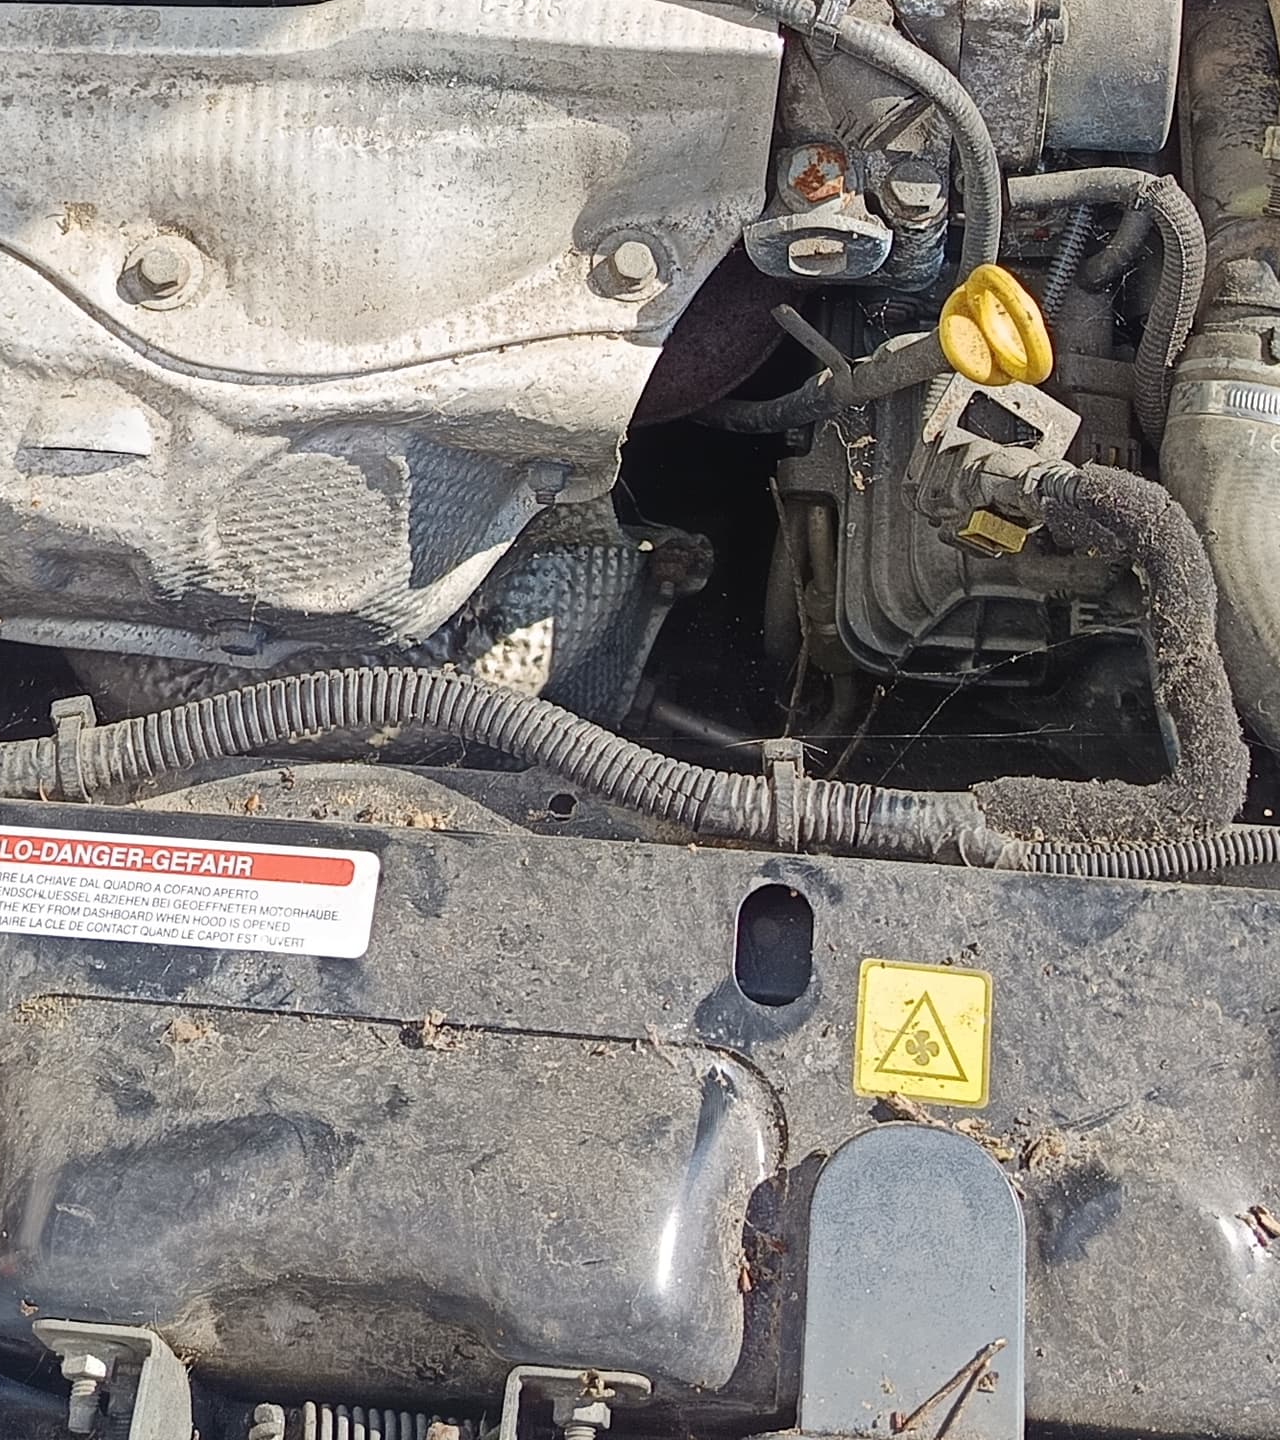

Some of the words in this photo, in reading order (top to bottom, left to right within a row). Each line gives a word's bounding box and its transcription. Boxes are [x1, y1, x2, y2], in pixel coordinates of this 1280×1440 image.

[20, 873, 34, 884] LA
[36, 874, 76, 887] CHIAVE
[80, 877, 100, 889] DAL
[103, 880, 151, 893] QUADRO
[154, 883, 162, 893] A
[164, 884, 211, 897] COFANO
[213, 888, 259, 900] APERTO
[22, 902, 45, 914] KEY
[47, 904, 81, 917] FROM
[83, 907, 153, 921] DASHBOARD
[156, 911, 190, 924] WHEN
[192, 915, 227, 927] HOOD
[229, 918, 240, 928] IS
[242, 918, 291, 932] OPENED
[94, 893, 149, 907] ABZIEHEN
[152, 898, 170, 908] BEI
[173, 900, 258, 915] GEOEFFNETER
[29, 918, 42, 928] LA
[44, 919, 65, 931] CLE
[68, 921, 83, 932] DE
[86, 922, 139, 936] CONTACT
[141, 926, 179, 939] QUAND
[181, 929, 194, 940] LE
[198, 930, 235, 943] CAPOT
[237, 933, 258, 945] EST
